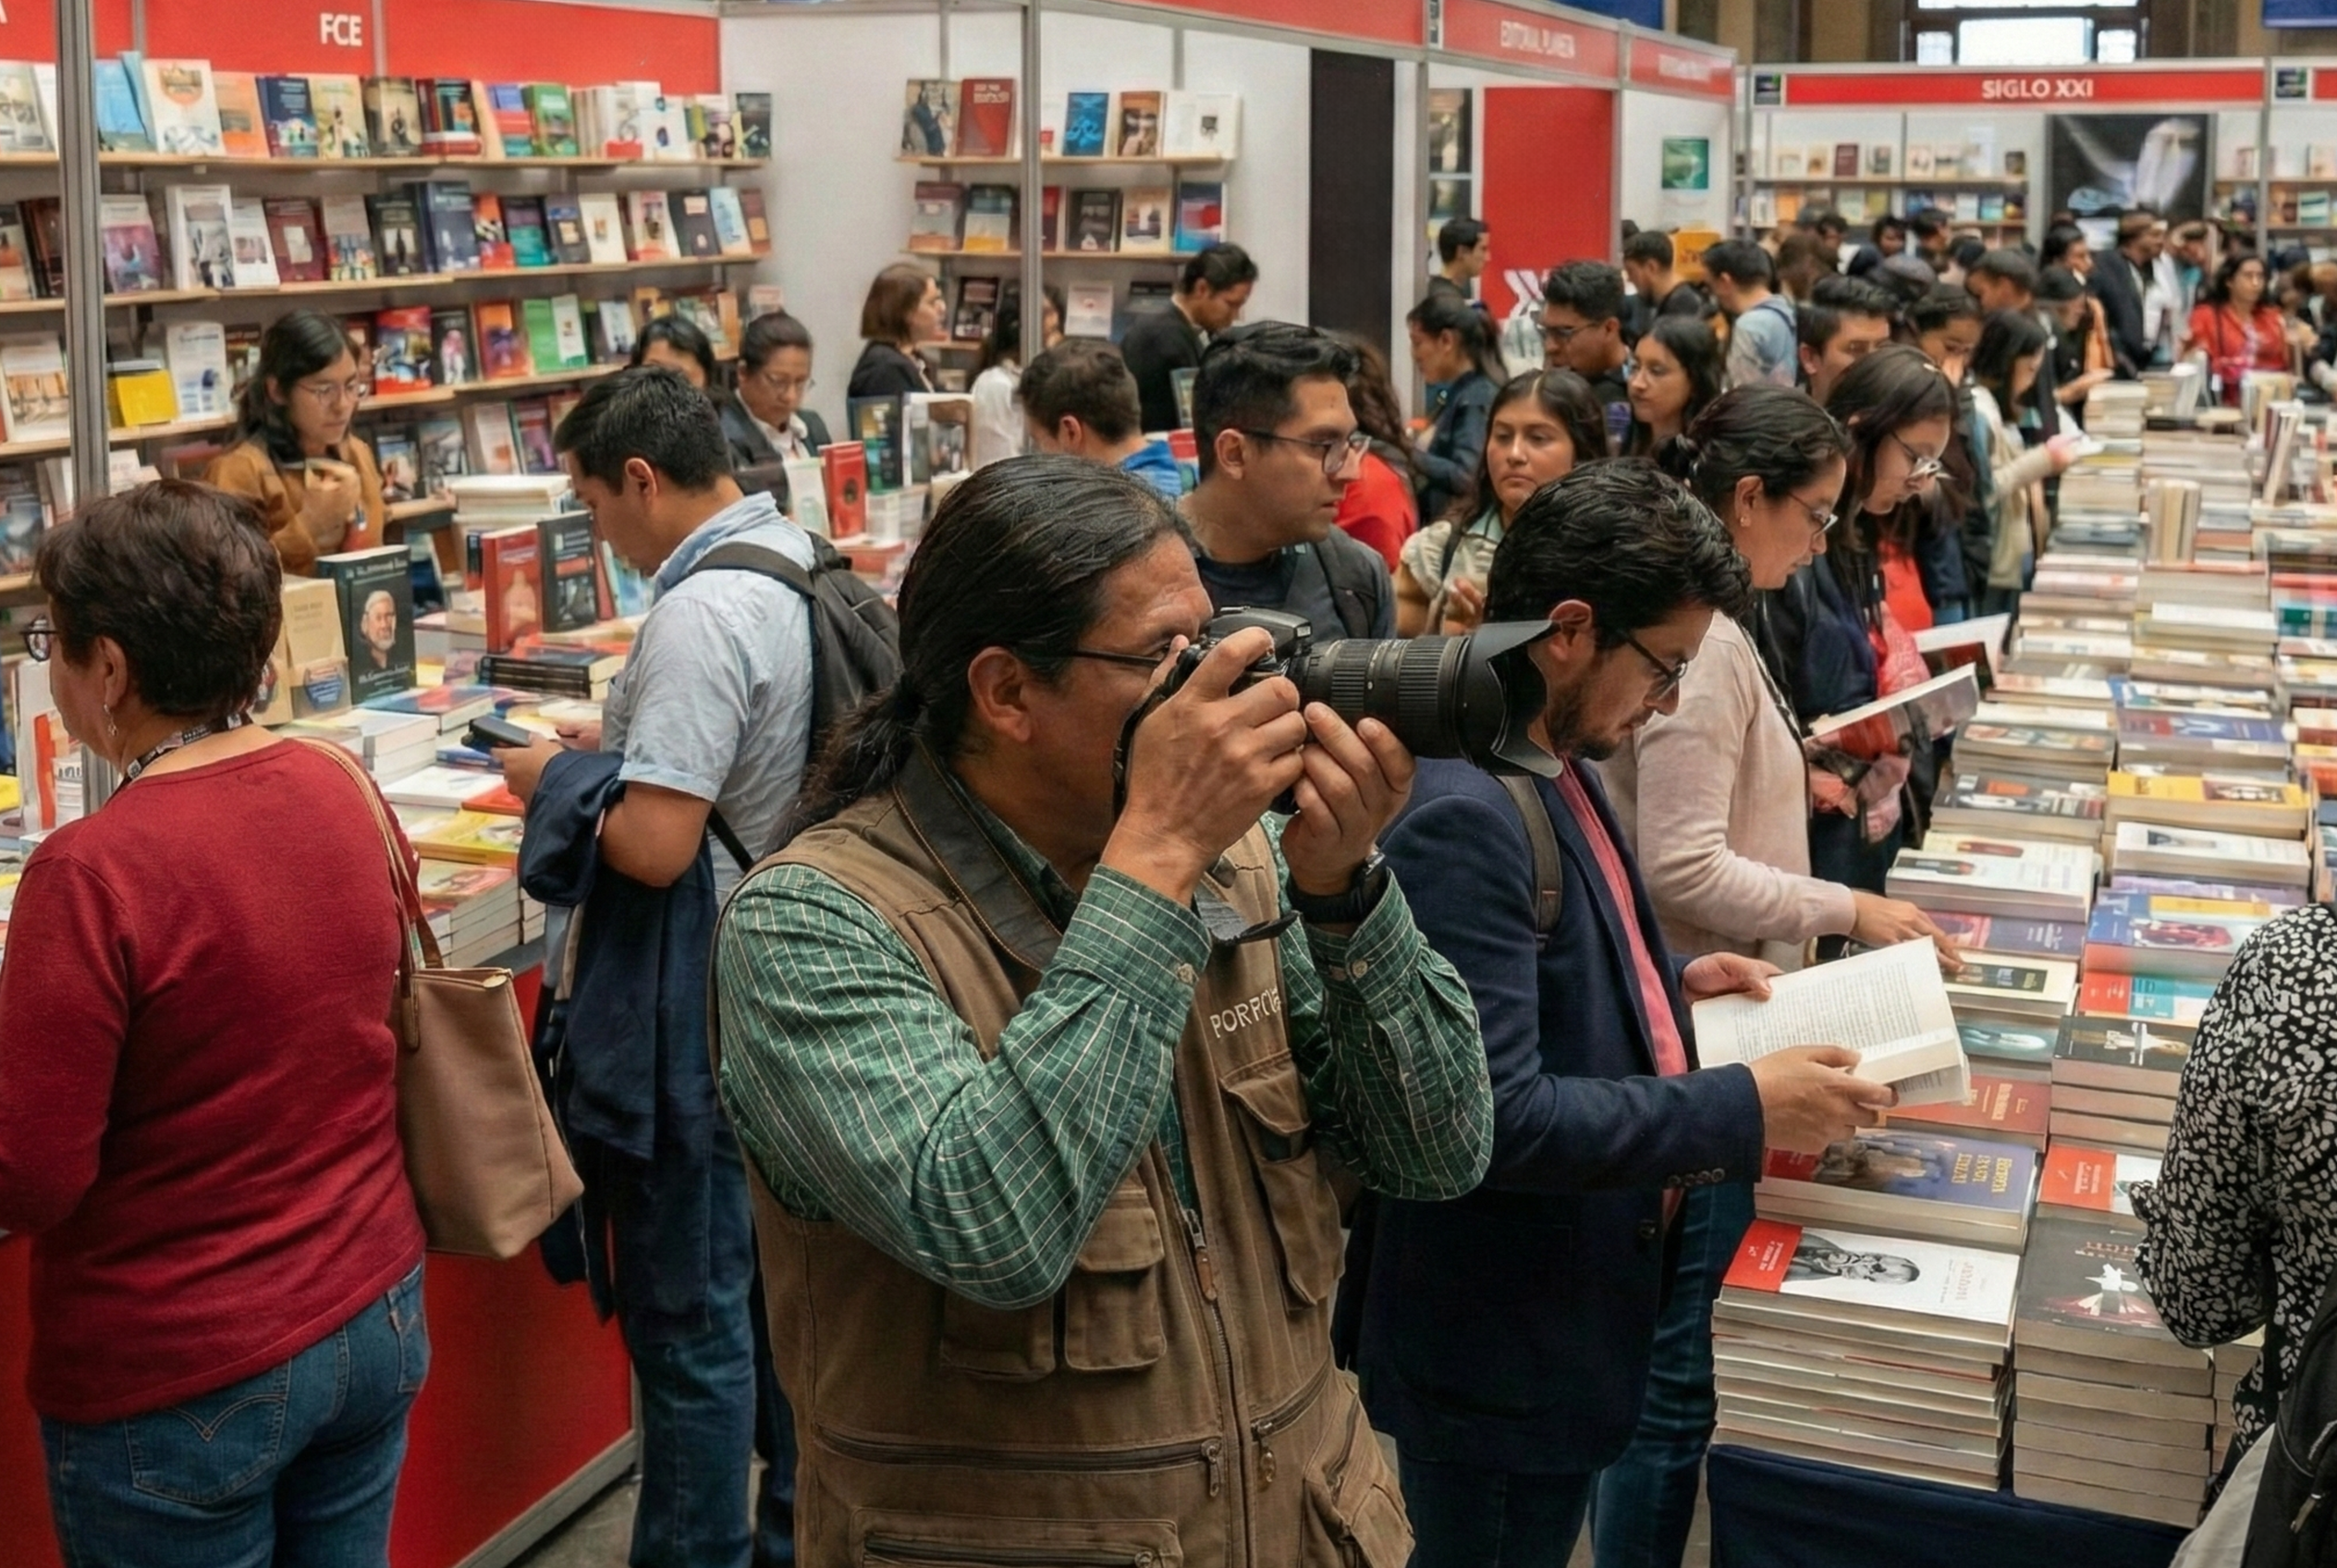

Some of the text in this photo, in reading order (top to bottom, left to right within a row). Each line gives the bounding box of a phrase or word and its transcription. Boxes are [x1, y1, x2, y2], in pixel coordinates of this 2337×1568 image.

[320, 13, 362, 46] FCE
[1982, 79, 2094, 99] SIGLO XXI
